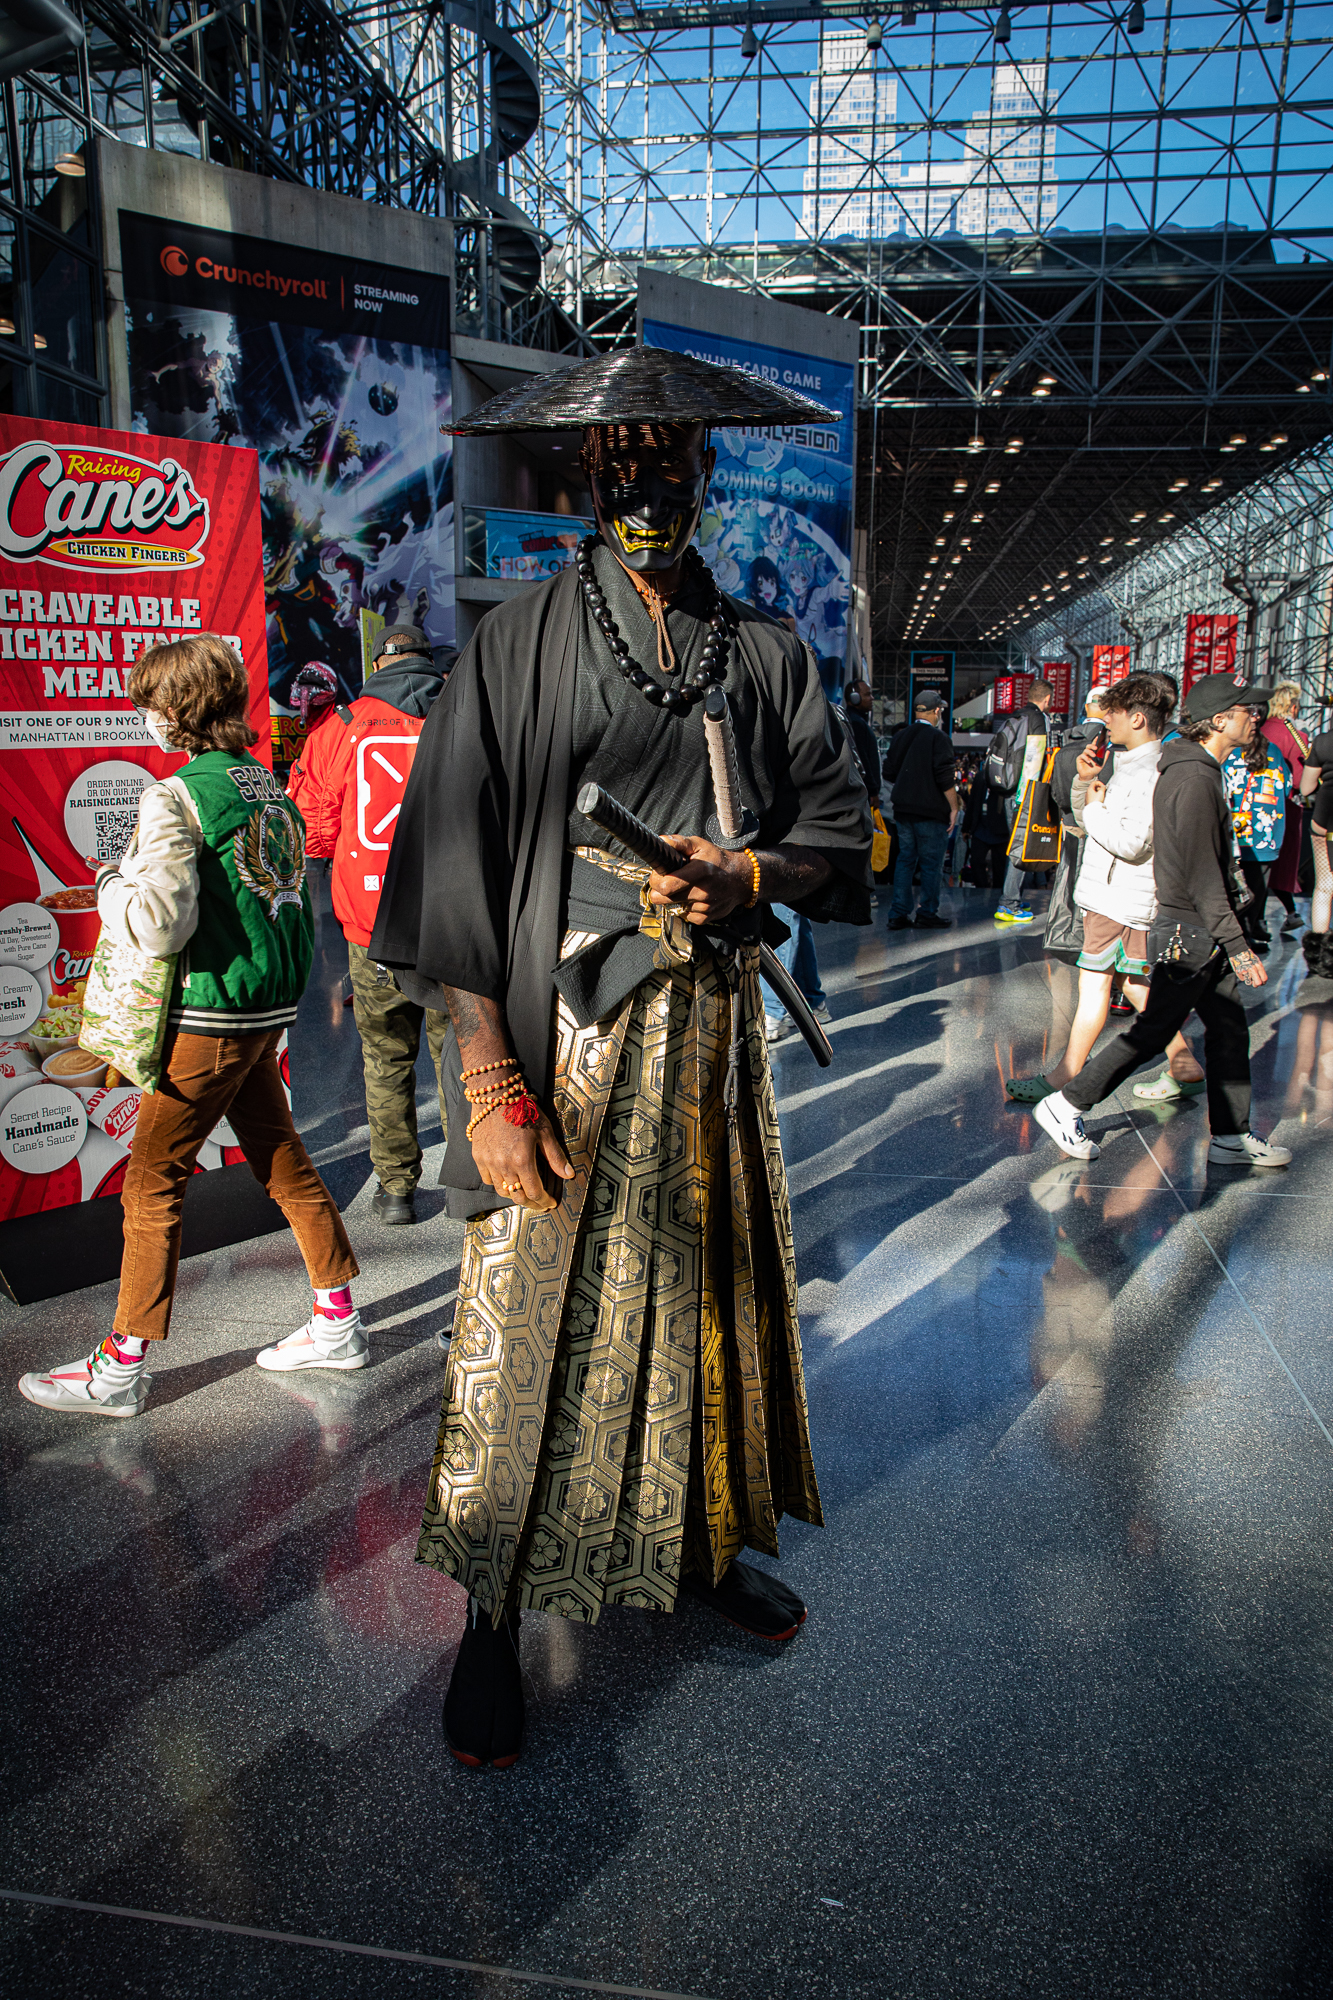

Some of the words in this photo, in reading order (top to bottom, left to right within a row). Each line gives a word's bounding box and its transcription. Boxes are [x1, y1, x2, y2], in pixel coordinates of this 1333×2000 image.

[195, 256, 327, 300] Crunchyroll
[354, 284, 419, 306] STREAMING
[354, 299, 383, 313] NOW
[742, 361, 779, 381] CARD
[783, 369, 822, 391] GAME
[67, 455, 141, 484] Raising
[711, 467, 778, 496] OMING
[781, 478, 836, 503] SOON!
[0, 443, 204, 556] Cane's
[67, 541, 127, 558] CHICKEN
[131, 546, 187, 563] FINGERS
[492, 555, 544, 573] SHOW
[0, 589, 202, 628] CRAVEABLE
[121, 632, 244, 664] FIR
[1058, 668, 1067, 707] CENTER
[26, 717, 52, 727] ONE
[56, 717, 73, 727] OF
[76, 717, 101, 726] OUR
[105, 717, 112, 726] 9
[116, 717, 139, 726] NYC
[356, 718, 388, 730] FABRIC
[390, 718, 401, 726] OF
[9, 732, 84, 743] MANHATTAN
[94, 731, 154, 741] BROOKLYN
[87, 780, 114, 789] ORDER
[116, 779, 144, 788] ONLINE
[87, 789, 98, 797] OR
[100, 789, 111, 797] ON
[113, 788, 129, 796] OUR
[131, 787, 145, 796] APP
[70, 797, 140, 808] RAISINGCANES
[7, 936, 20, 944] Day,
[21, 932, 52, 942] Sweetened
[72, 949, 95, 958] Raisi
[3, 985, 33, 994] Creamy
[10, 1111, 40, 1124] Secret
[42, 1105, 72, 1118] Recipe
[101, 1094, 142, 1139] Cane's
[5, 1116, 79, 1140] Handmade
[12, 1139, 44, 1154] Cane's
[47, 1134, 76, 1147] Sauce
